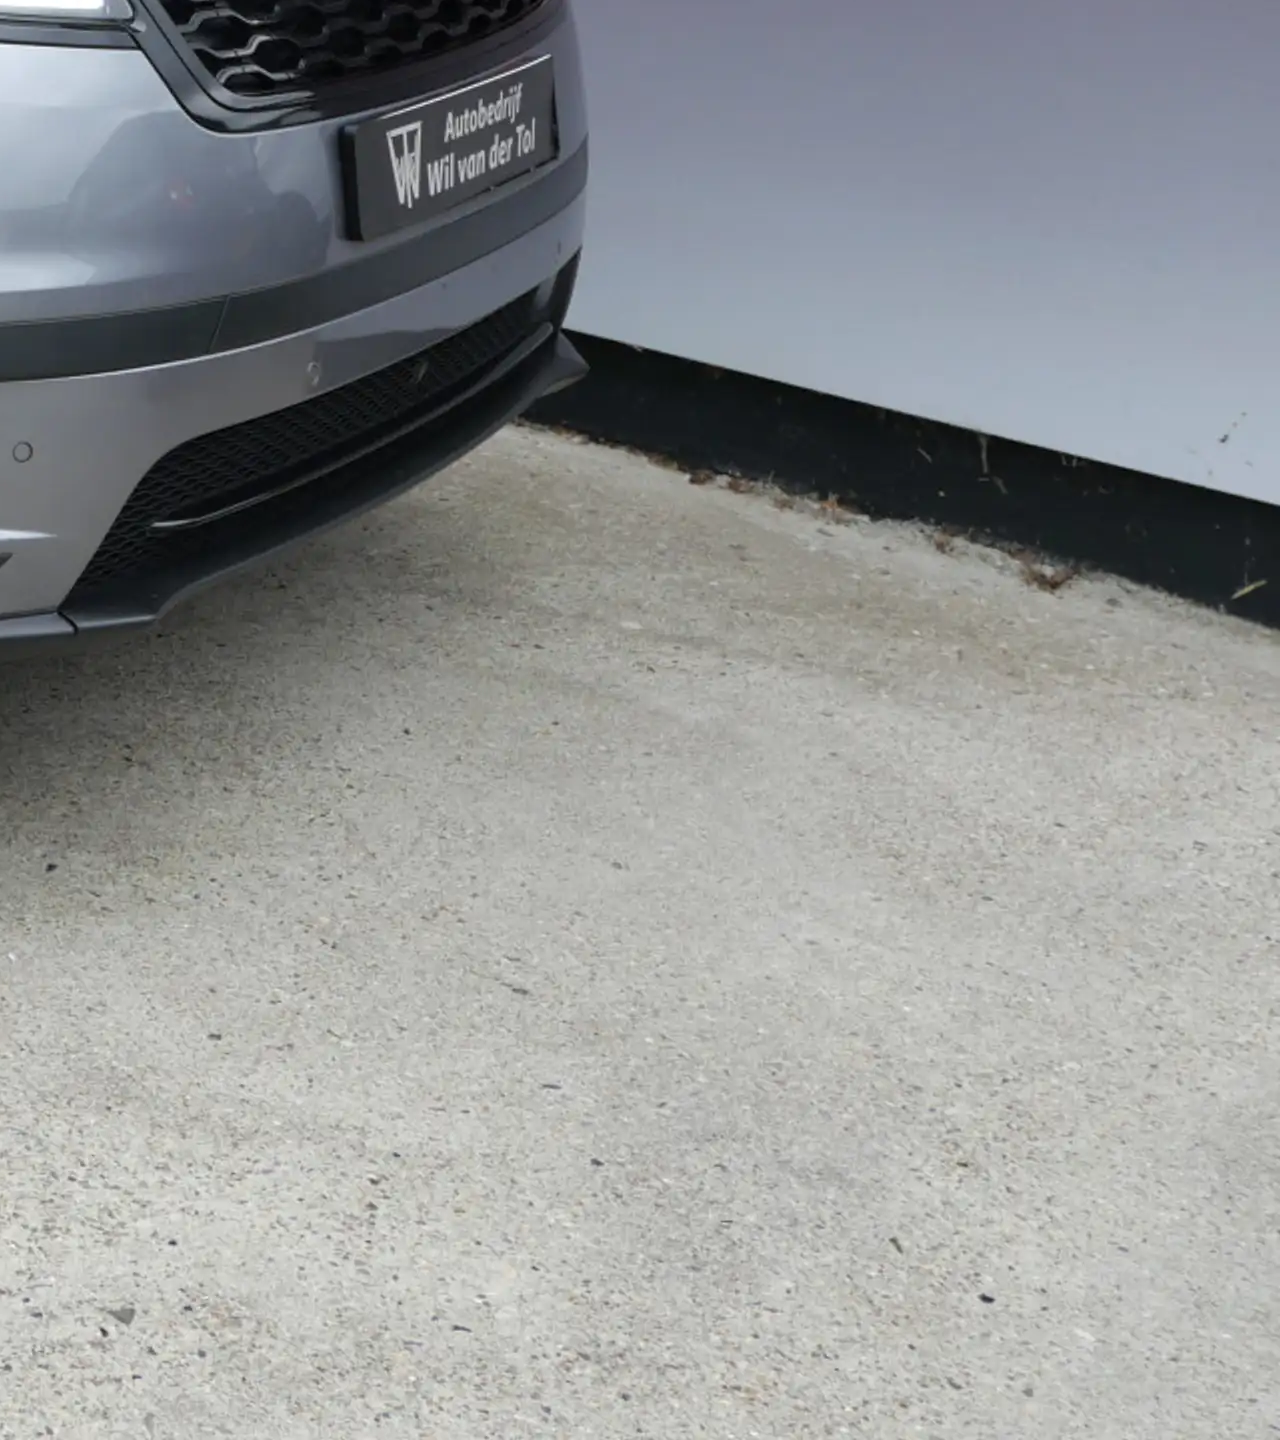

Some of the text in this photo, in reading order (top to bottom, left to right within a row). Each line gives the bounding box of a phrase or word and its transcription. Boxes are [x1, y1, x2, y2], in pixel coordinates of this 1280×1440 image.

[443, 82, 524, 143] Autobedrijf
[426, 116, 536, 197] Wil van der Tol
